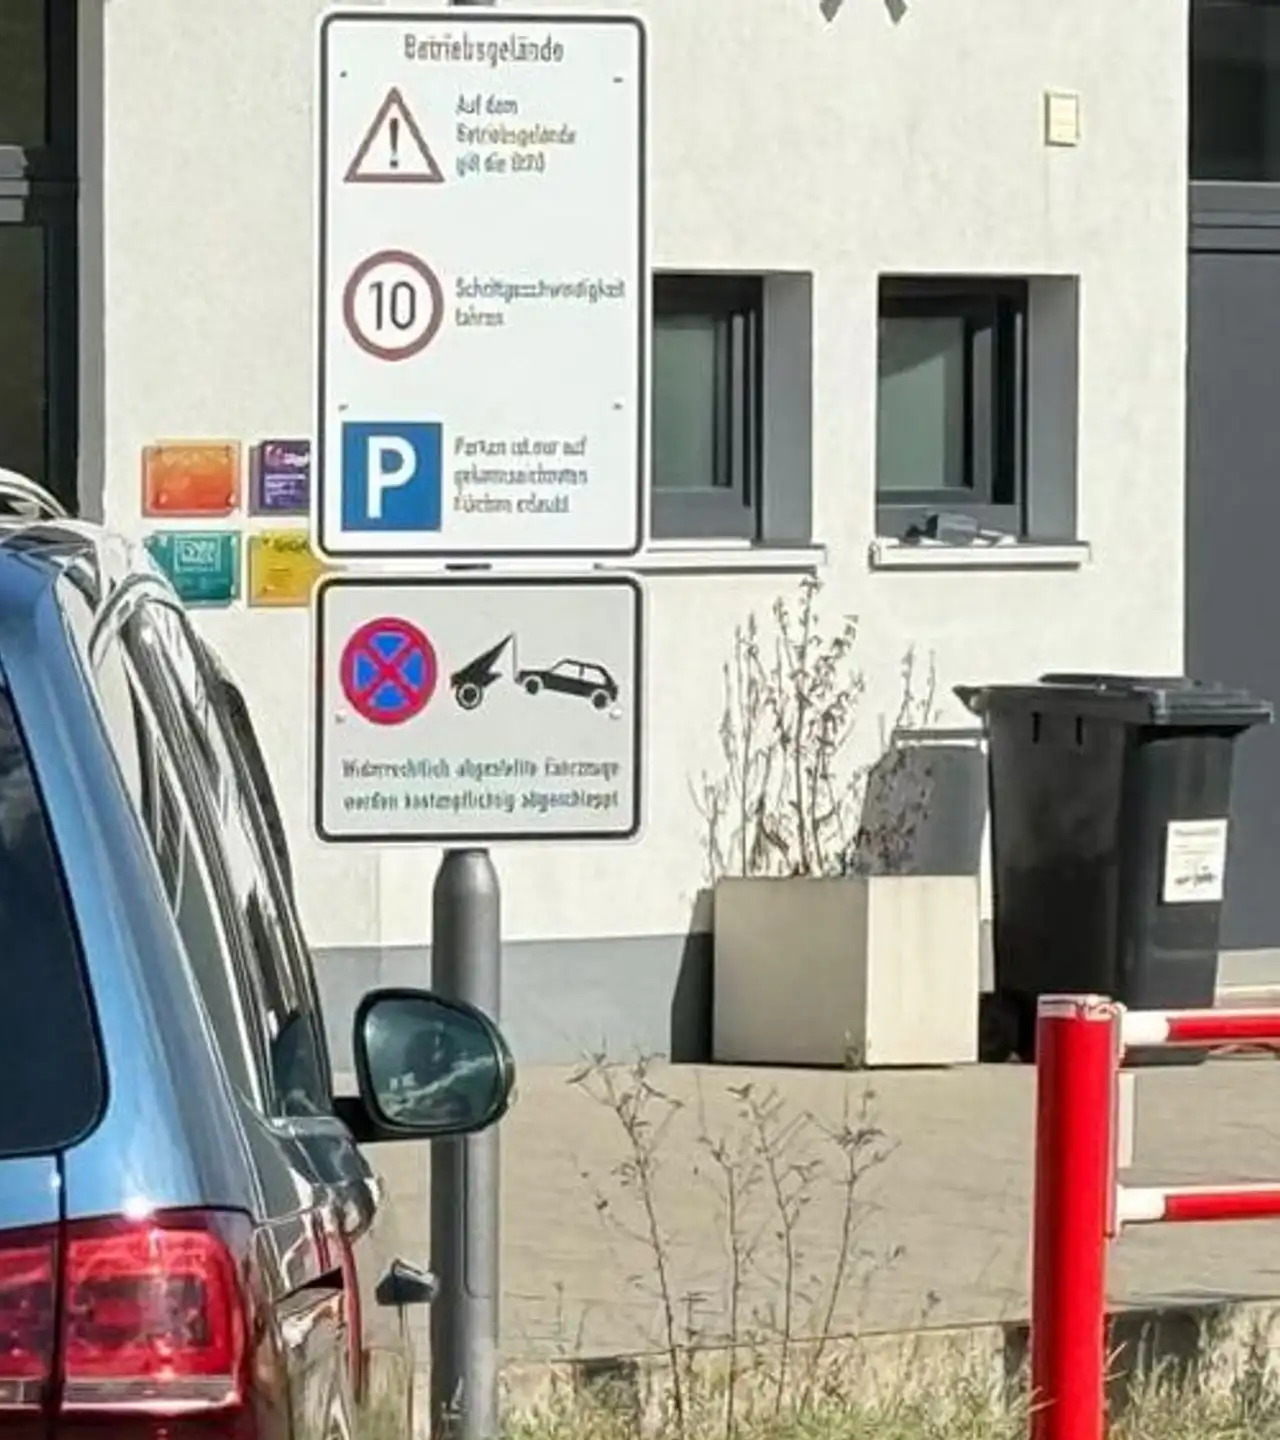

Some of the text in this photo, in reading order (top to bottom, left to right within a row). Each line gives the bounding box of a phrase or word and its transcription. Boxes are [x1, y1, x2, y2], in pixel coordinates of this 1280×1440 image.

[403, 32, 565, 68] Betriebsgelände
[369, 280, 416, 331] 10
[366, 435, 417, 519] P
